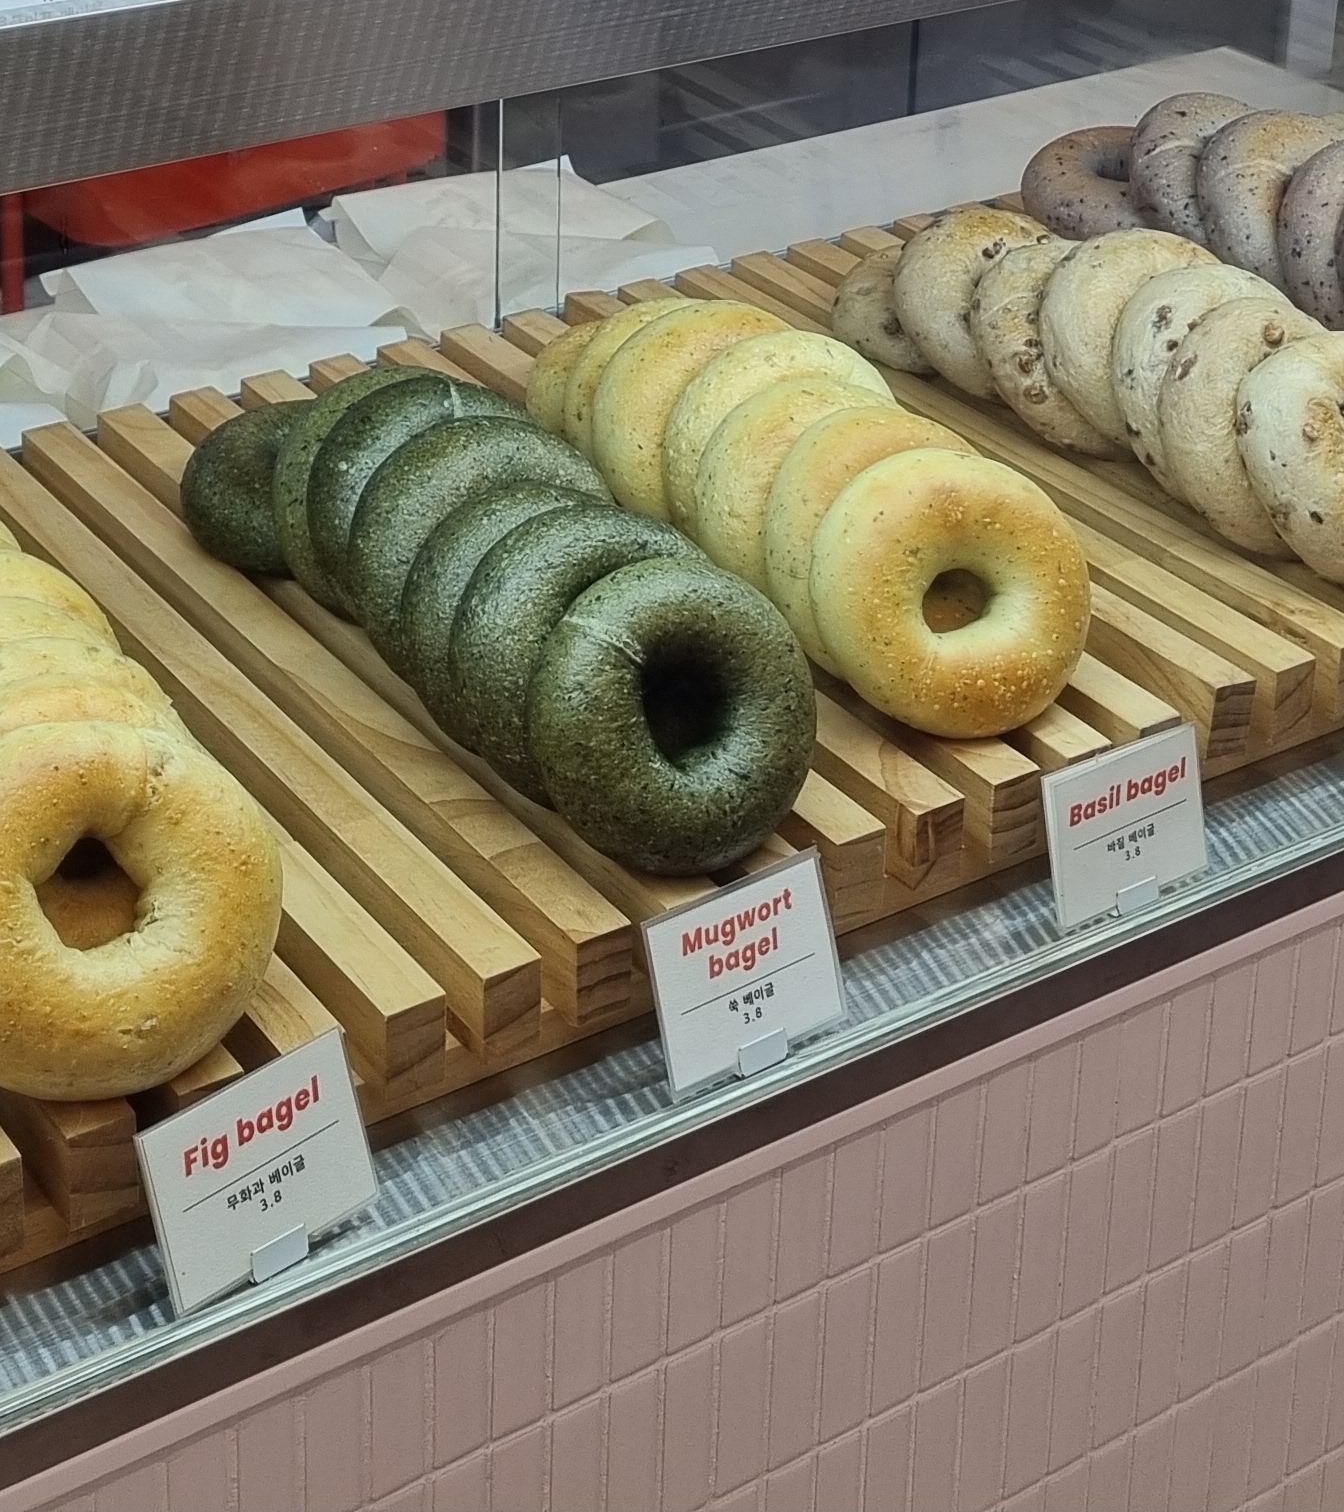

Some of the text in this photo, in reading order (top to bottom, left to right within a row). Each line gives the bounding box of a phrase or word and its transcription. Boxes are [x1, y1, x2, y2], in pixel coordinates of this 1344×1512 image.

[1069, 757, 1186, 827] Basil bagel
[1107, 823, 1155, 853] 바질 베이글
[1125, 846, 1141, 861] 3.8
[682, 888, 792, 956] Mugwort
[709, 927, 779, 979] bagel
[729, 983, 775, 1012] 쑥 베이글
[743, 1007, 763, 1024] 3.8
[183, 1075, 320, 1177] Fig bagel
[227, 1155, 306, 1211] 무화과 베이글
[260, 1191, 282, 1212] 3.8
